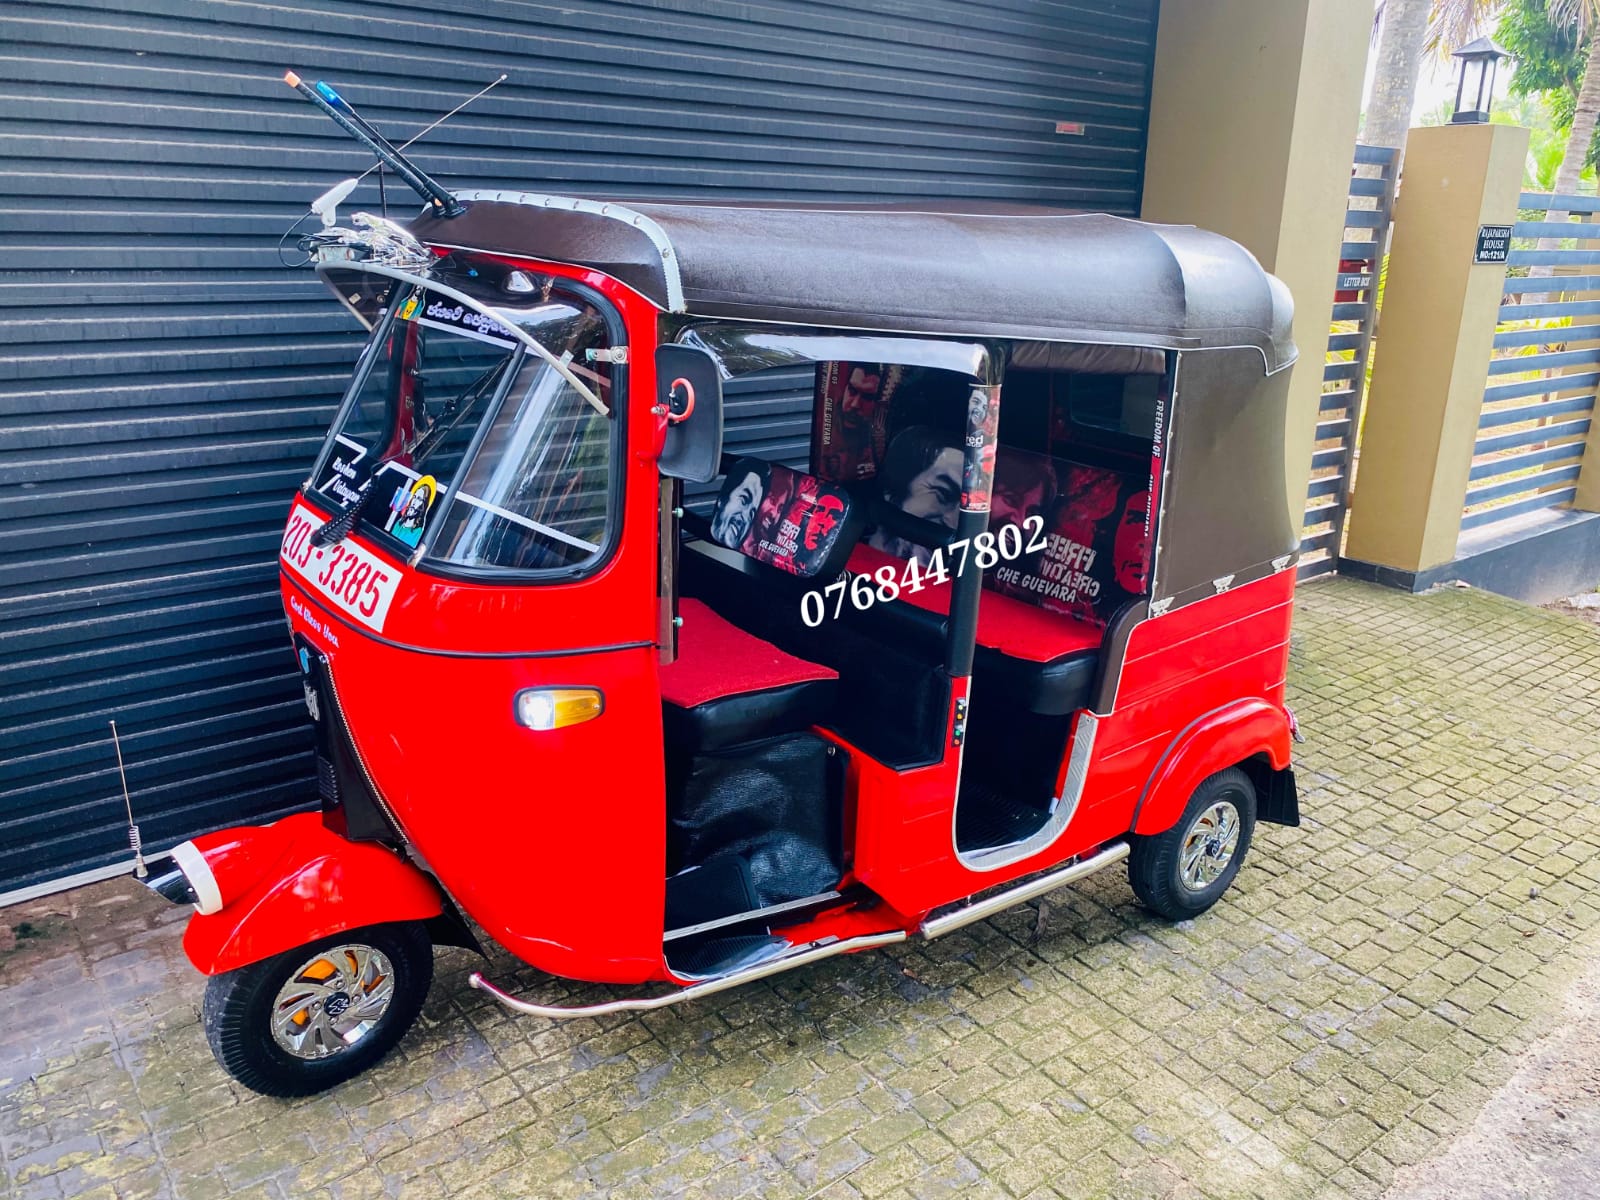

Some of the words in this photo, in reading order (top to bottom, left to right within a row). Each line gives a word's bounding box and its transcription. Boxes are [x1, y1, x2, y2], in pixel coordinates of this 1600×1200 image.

[1483, 239, 1505, 249] HOUSE
[1343, 277, 1361, 287] LETTER
[1360, 276, 1370, 287] BOX
[823, 413, 832, 446] GUEVARA
[1152, 399, 1165, 445] FREEDOM
[1151, 445, 1161, 458] OF
[996, 566, 1018, 585] CHE
[1021, 573, 1077, 603] GUEVARA
